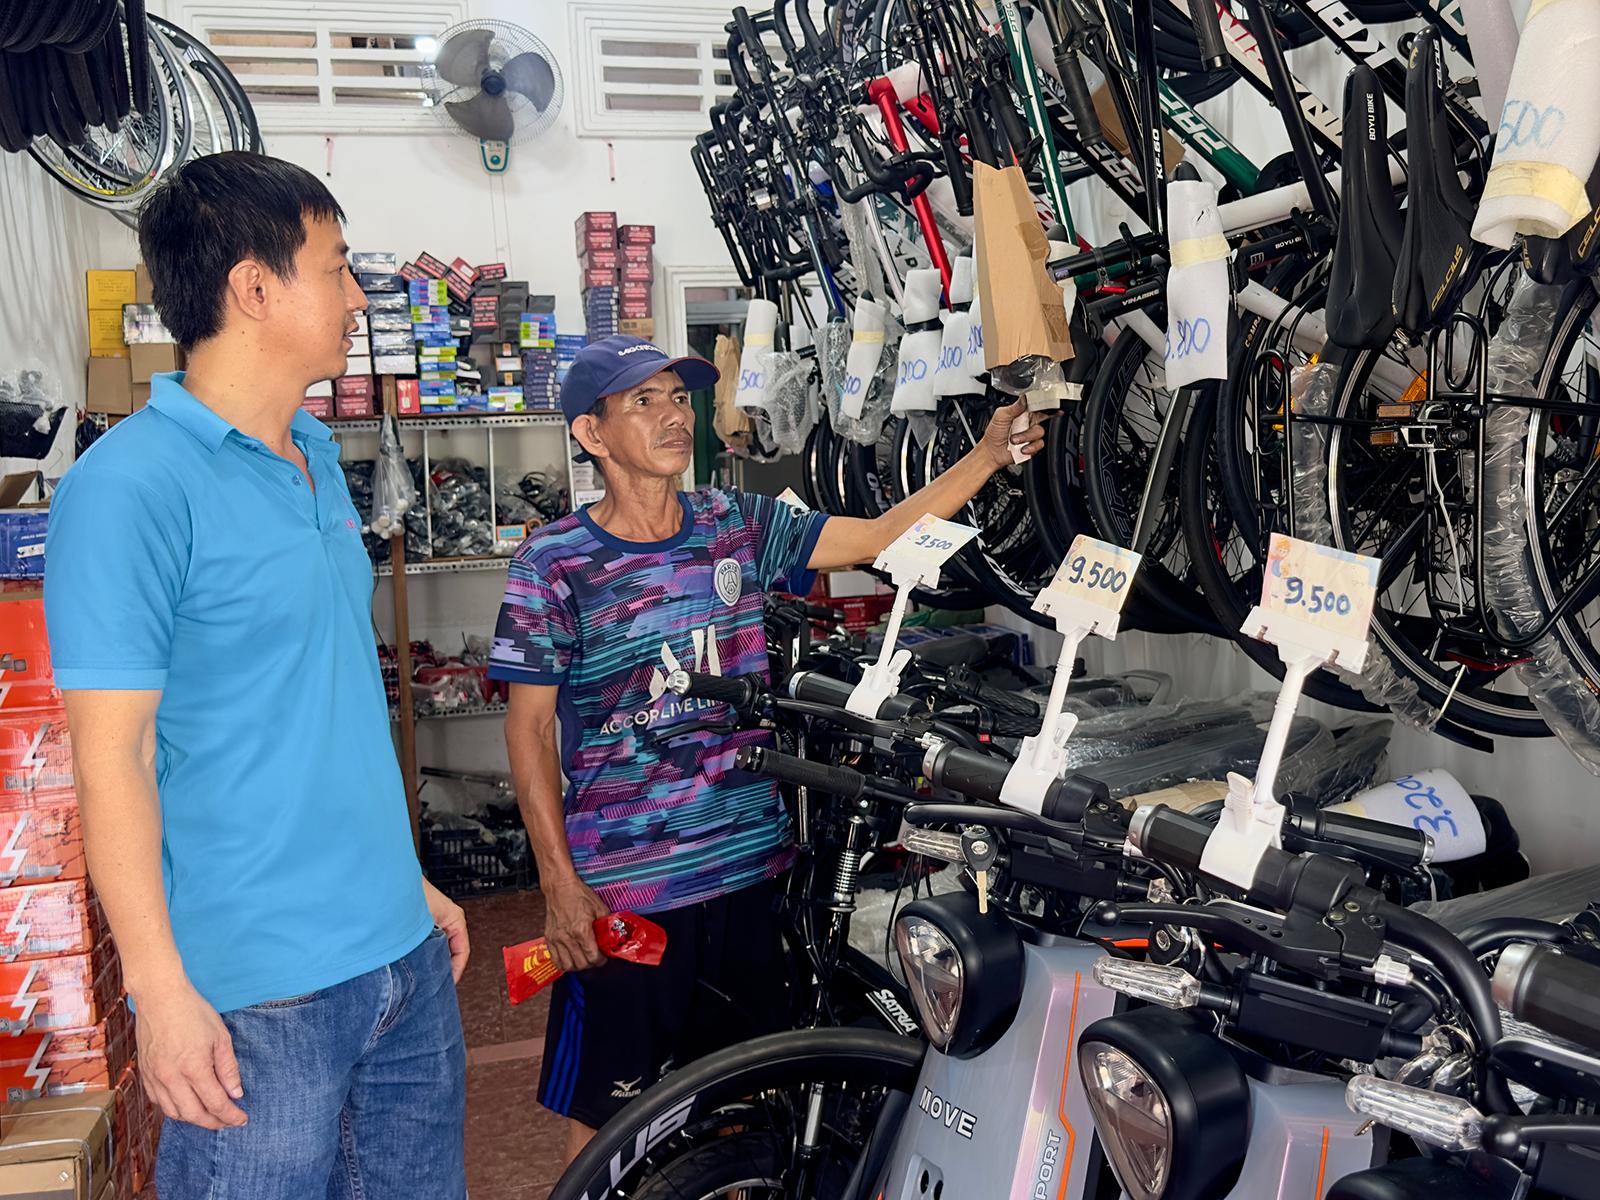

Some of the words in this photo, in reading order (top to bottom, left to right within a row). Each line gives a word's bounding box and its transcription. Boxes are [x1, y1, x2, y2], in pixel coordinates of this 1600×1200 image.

[1305, 0, 1396, 69] KA
[1366, 93, 1375, 112] BIKE
[1369, 114, 1377, 140] BOYU
[1122, 288, 1160, 306] VINABIKE
[720, 563, 738, 576] PARIS
[1069, 555, 1127, 594] 9.500
[1283, 576, 1352, 617] 9.500
[873, 988, 918, 1034] SATRIA
[919, 1085, 978, 1140] MOVE
